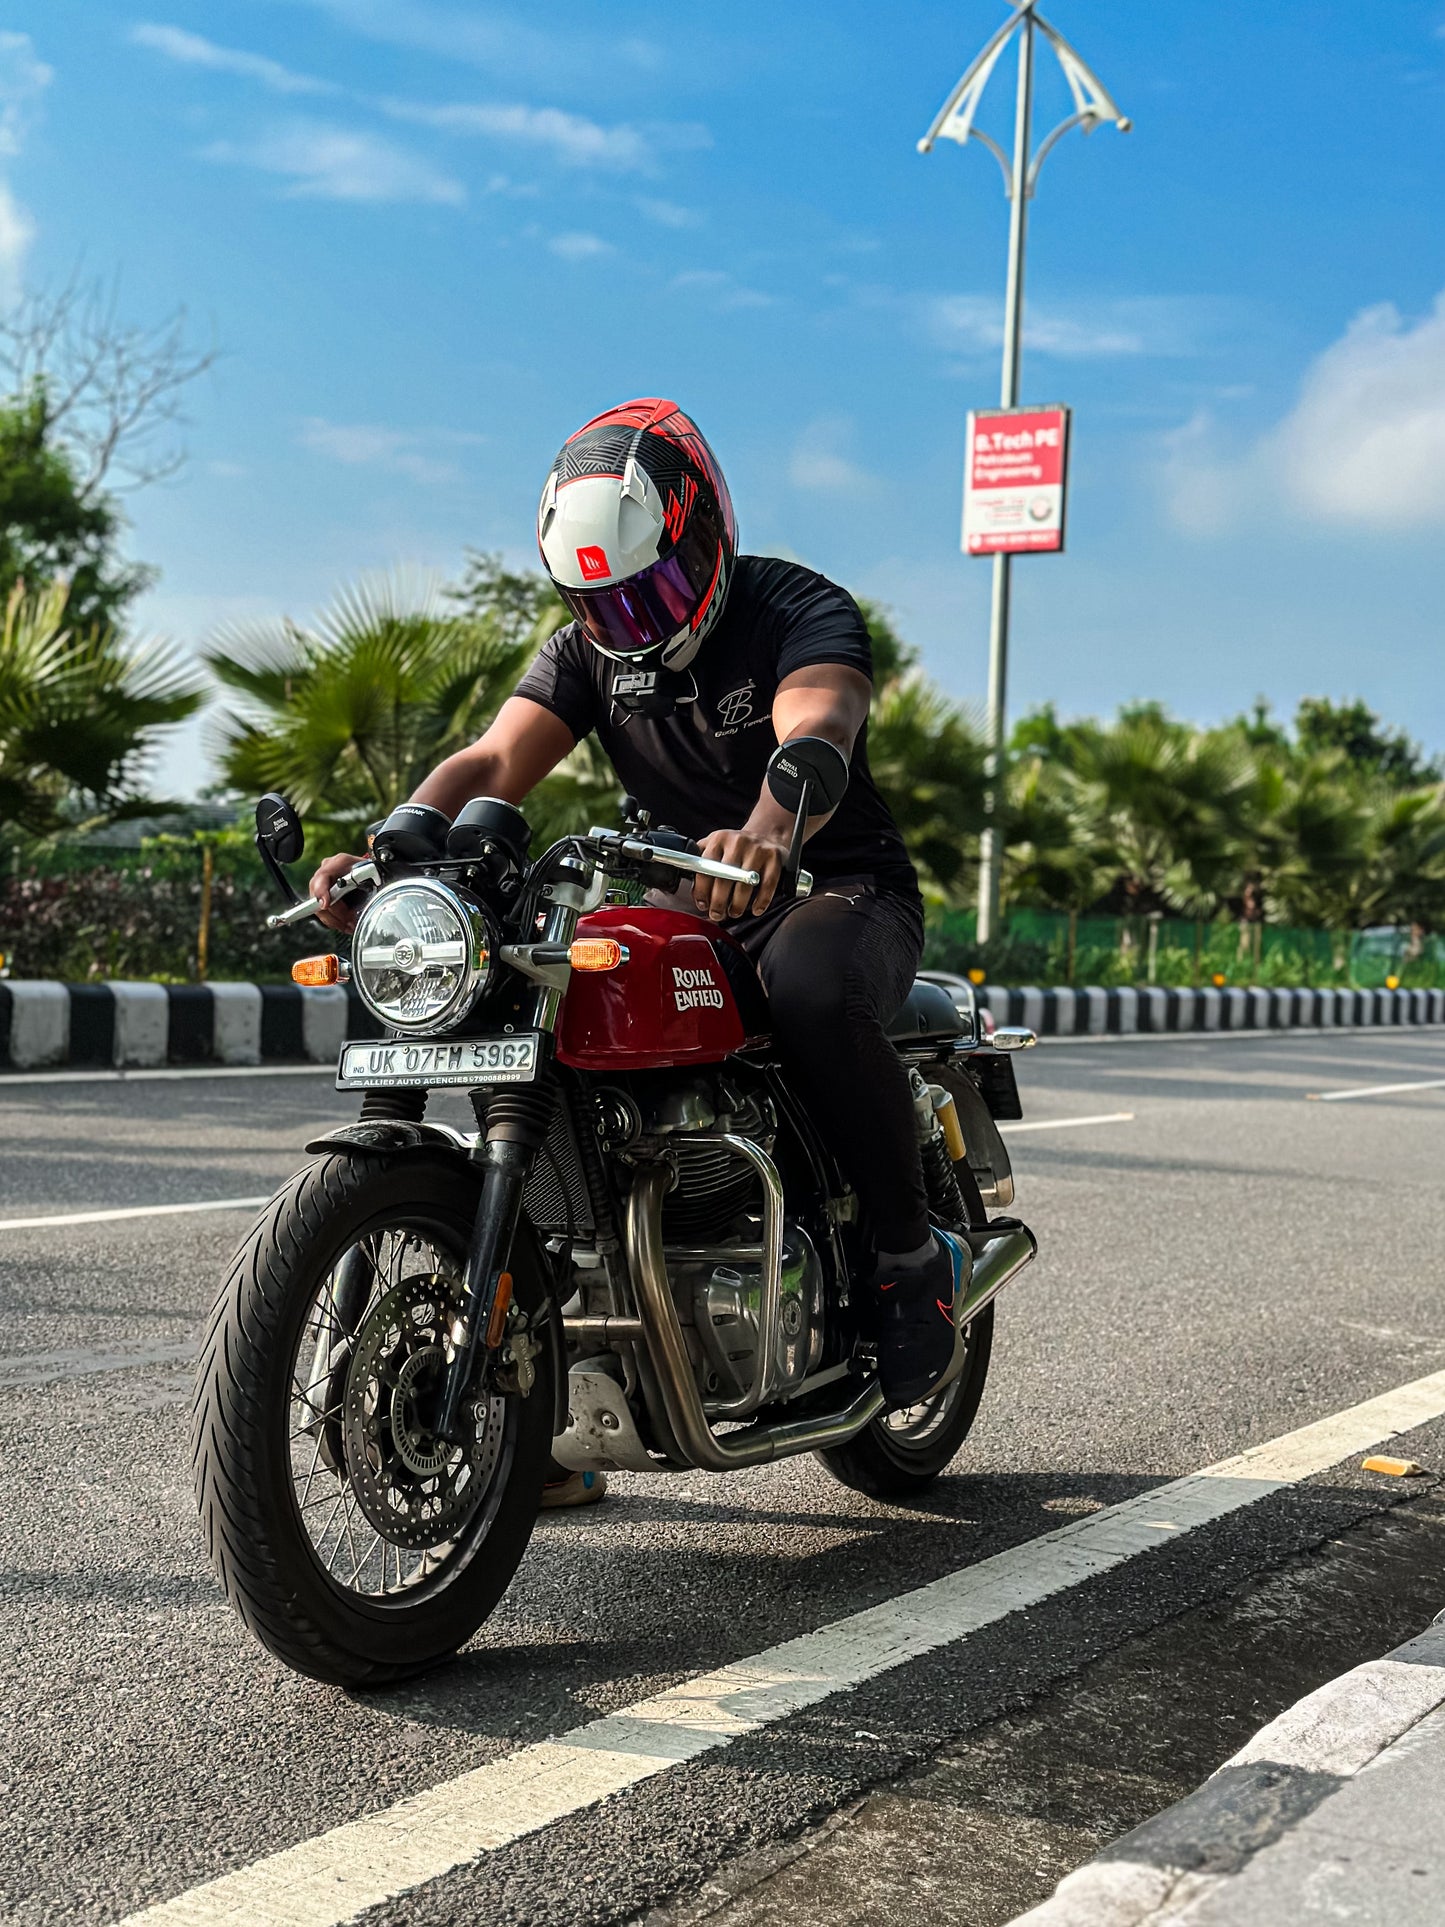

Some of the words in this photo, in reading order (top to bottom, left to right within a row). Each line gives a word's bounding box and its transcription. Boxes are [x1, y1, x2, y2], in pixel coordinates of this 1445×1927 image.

[672, 967, 715, 989] ROYAL
[674, 989, 724, 1011] ENFIELD
[369, 1050, 396, 1074] UK
[472, 1043, 530, 1069] 5962
[352, 1066, 365, 1074] IND
[396, 1078, 421, 1086] AUTO
[423, 1077, 468, 1085] AGENCIES
